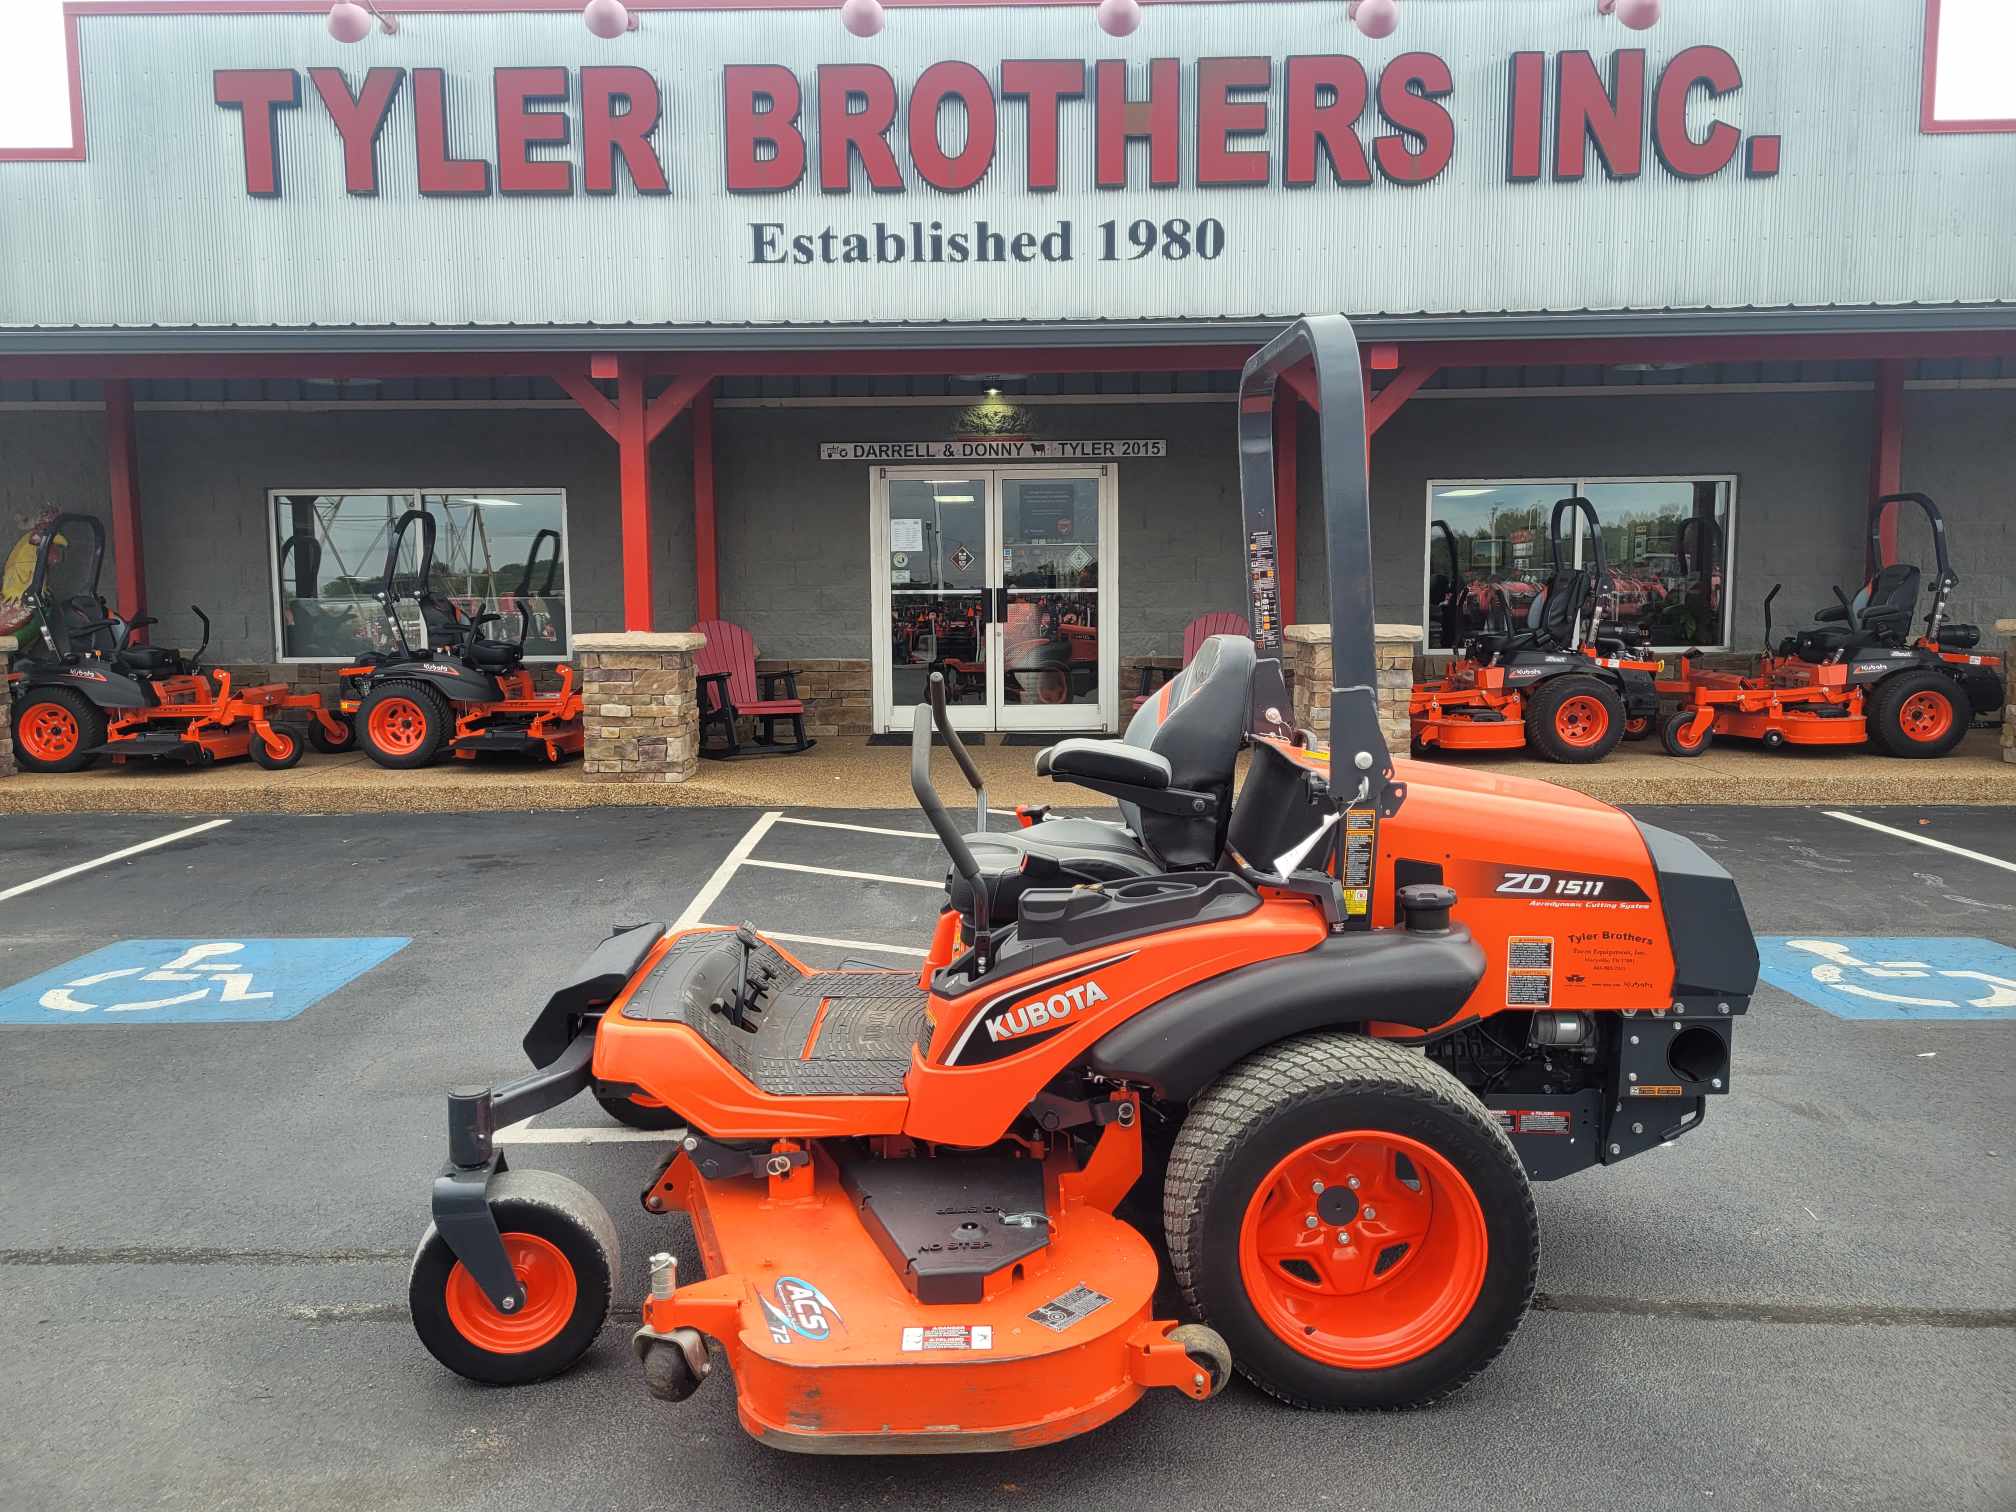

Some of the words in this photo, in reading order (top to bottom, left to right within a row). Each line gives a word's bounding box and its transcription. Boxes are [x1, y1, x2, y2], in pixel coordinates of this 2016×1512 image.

[213, 65, 671, 198] TYLER
[723, 52, 1455, 193] BROTHERS
[1505, 44, 1782, 183] INC.
[748, 220, 1073, 264] Established
[1098, 217, 1225, 262] 1980
[853, 443, 936, 459] DARRELL
[943, 444, 956, 458] &
[961, 443, 1025, 458] DONNY
[1058, 442, 1115, 457] TYLER
[1121, 441, 1161, 457] 2015
[1496, 872, 1553, 894] ZD
[1555, 879, 1605, 896] 1511
[1585, 901, 1618, 911] Cutting
[1619, 902, 1650, 911] System
[1568, 932, 1598, 945] Tyler
[1602, 930, 1654, 946] Brothers
[985, 980, 1109, 1043] KUBOTA
[784, 1284, 829, 1331] ACS
